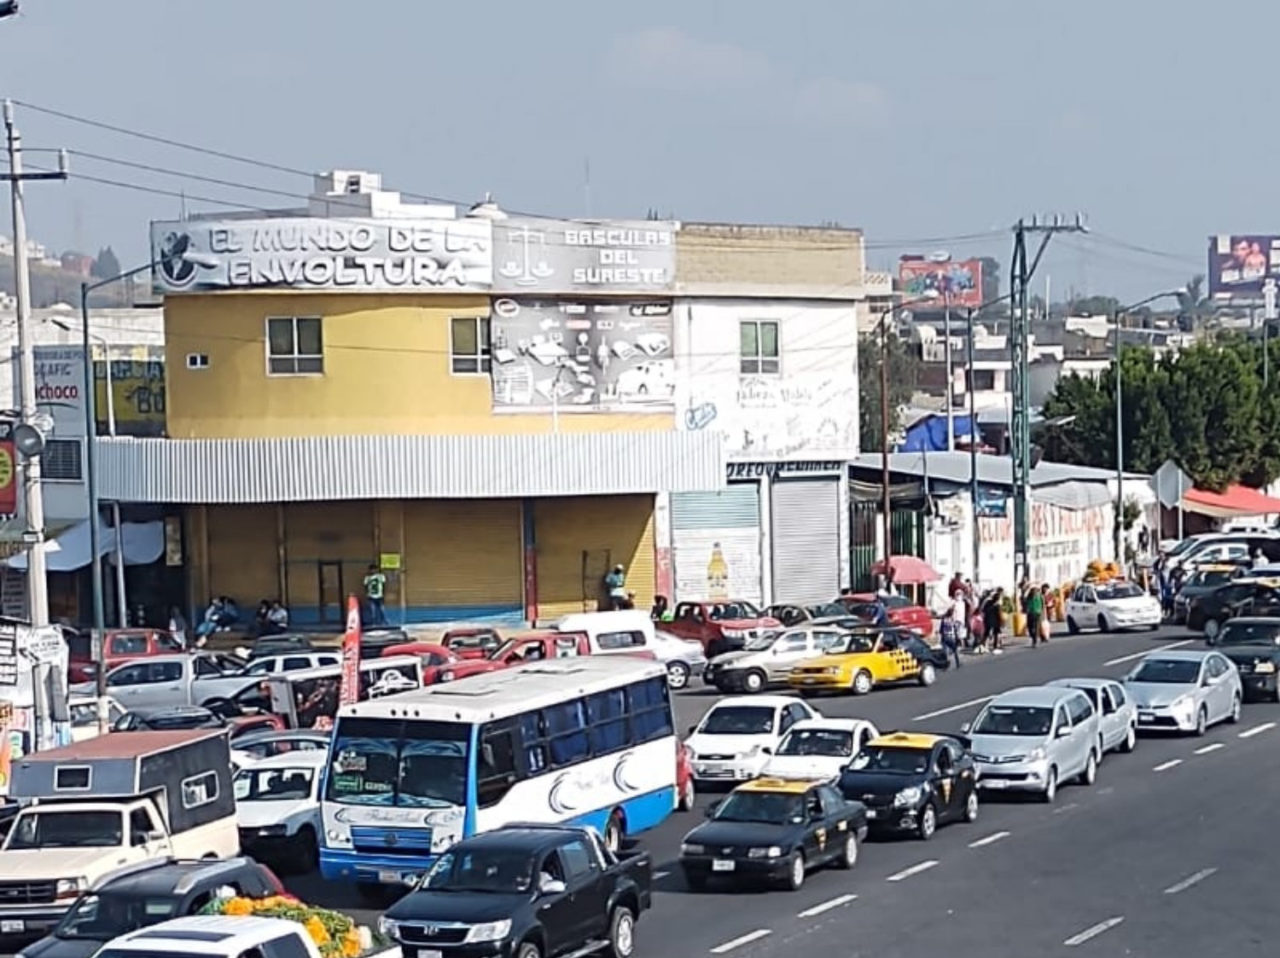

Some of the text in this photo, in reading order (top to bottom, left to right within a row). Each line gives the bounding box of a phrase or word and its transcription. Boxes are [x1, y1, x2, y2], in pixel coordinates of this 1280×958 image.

[209, 226, 487, 253] EL MUNDO DE LA
[564, 229, 672, 246] BASCULAS
[599, 249, 639, 265] DEL
[226, 255, 467, 286] ENVOLTURA
[573, 267, 665, 284] SURESTE
